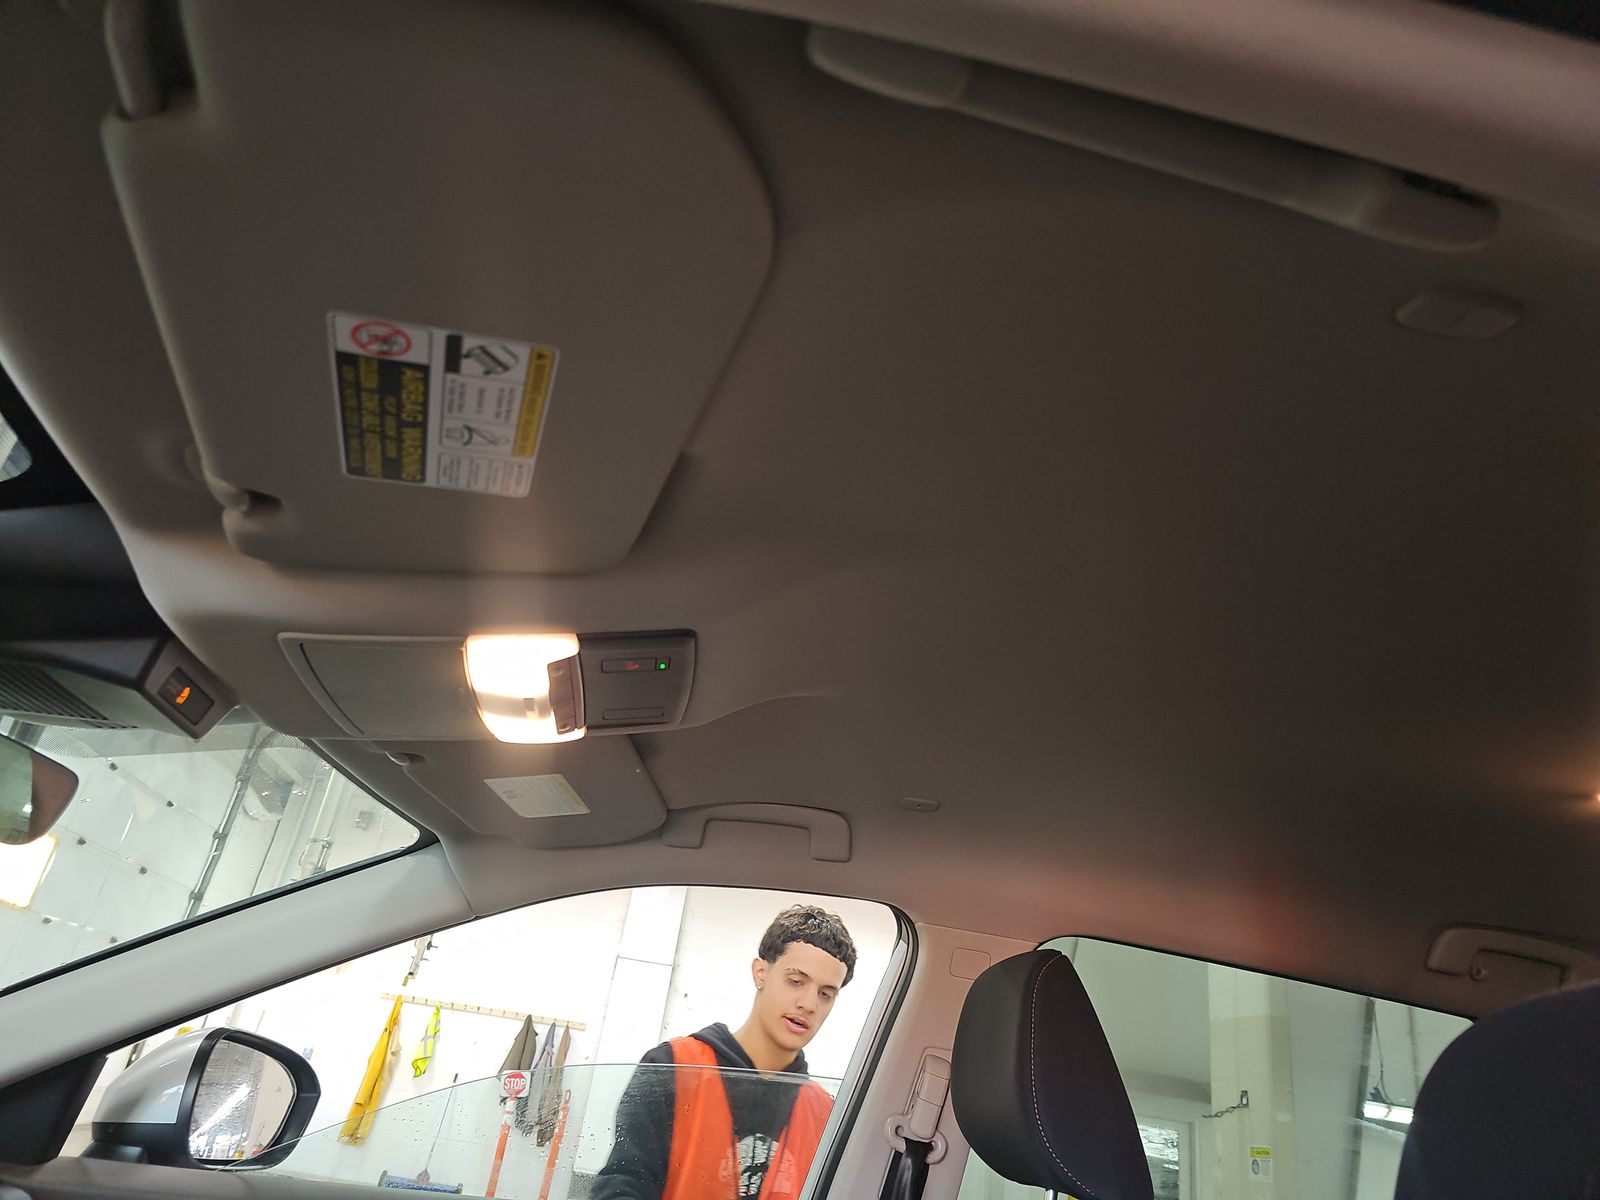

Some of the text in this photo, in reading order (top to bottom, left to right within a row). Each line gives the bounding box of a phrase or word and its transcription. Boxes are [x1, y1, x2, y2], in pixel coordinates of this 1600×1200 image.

[400, 368, 425, 481] AIRBAG WARNING
[504, 1078, 526, 1089] STOP
